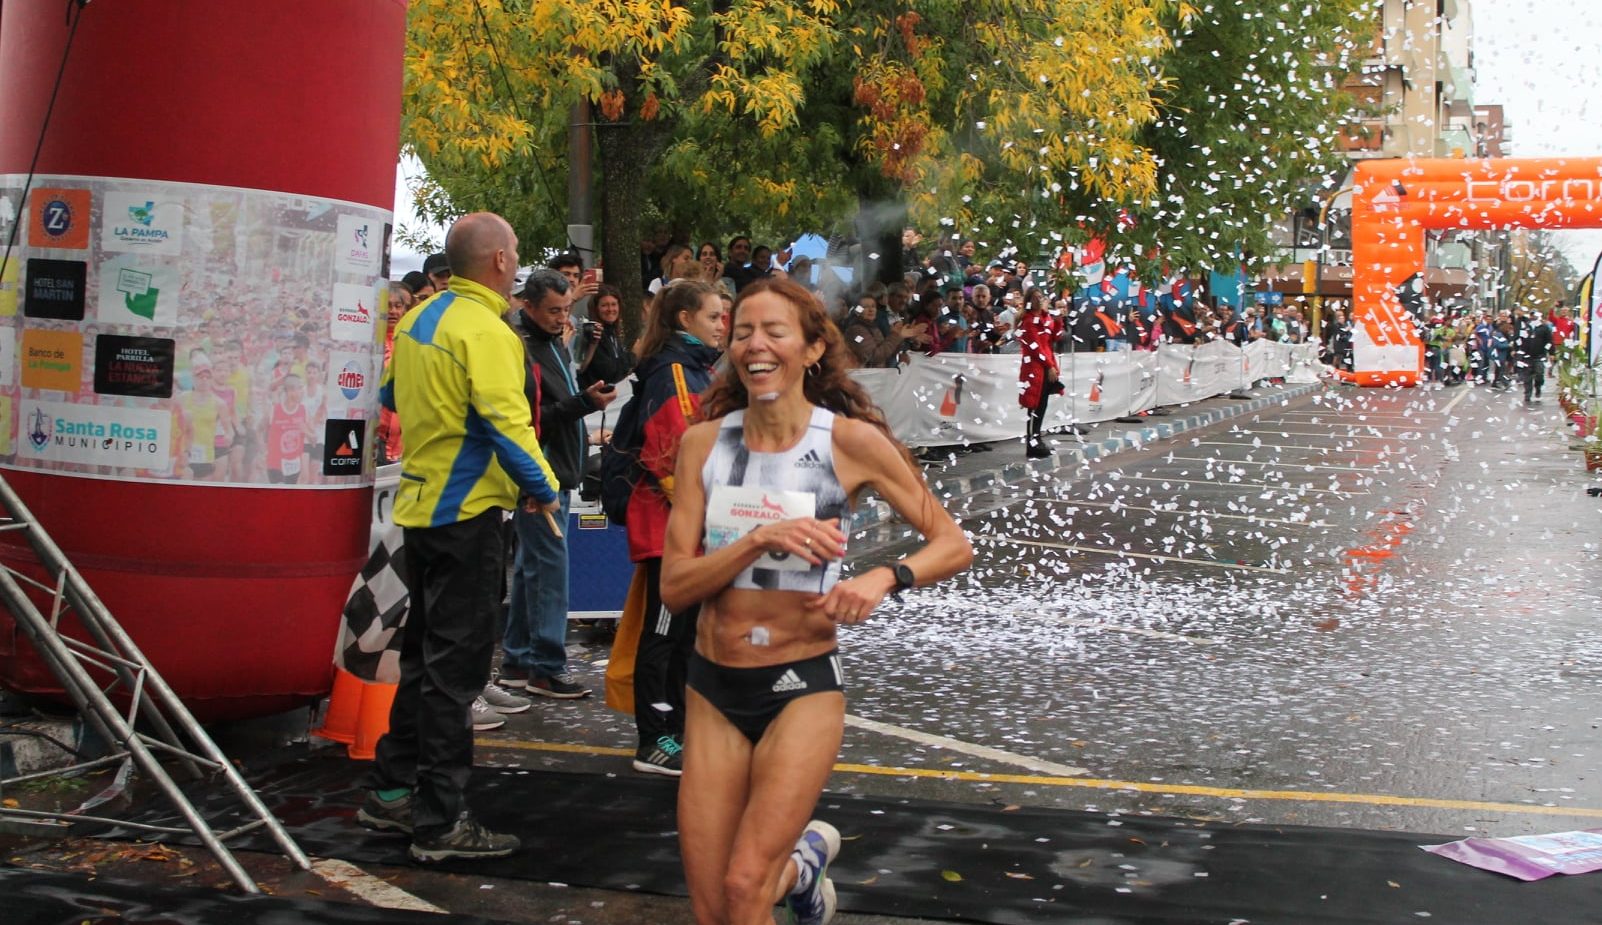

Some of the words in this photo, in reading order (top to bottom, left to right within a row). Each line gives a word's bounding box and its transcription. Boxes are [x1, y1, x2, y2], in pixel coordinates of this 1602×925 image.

[1465, 178, 1602, 201] corn
[47, 207, 65, 229] Z
[114, 227, 130, 237] LA
[131, 228, 169, 239] PAMPA
[33, 277, 55, 288] HOTEL
[55, 279, 75, 289] SAN
[337, 313, 368, 324] GONZALO
[29, 347, 52, 358] Banco
[53, 349, 65, 359] de
[121, 348, 150, 356] HOTEL
[116, 354, 155, 363] PARRILLA
[55, 418, 105, 437] Santa
[110, 422, 158, 440] Rosa
[55, 436, 158, 454] MUNICIPIO
[330, 456, 361, 467] corner
[794, 461, 825, 469] adidas
[730, 508, 781, 520] GONZALO
[772, 681, 808, 693] adidas
